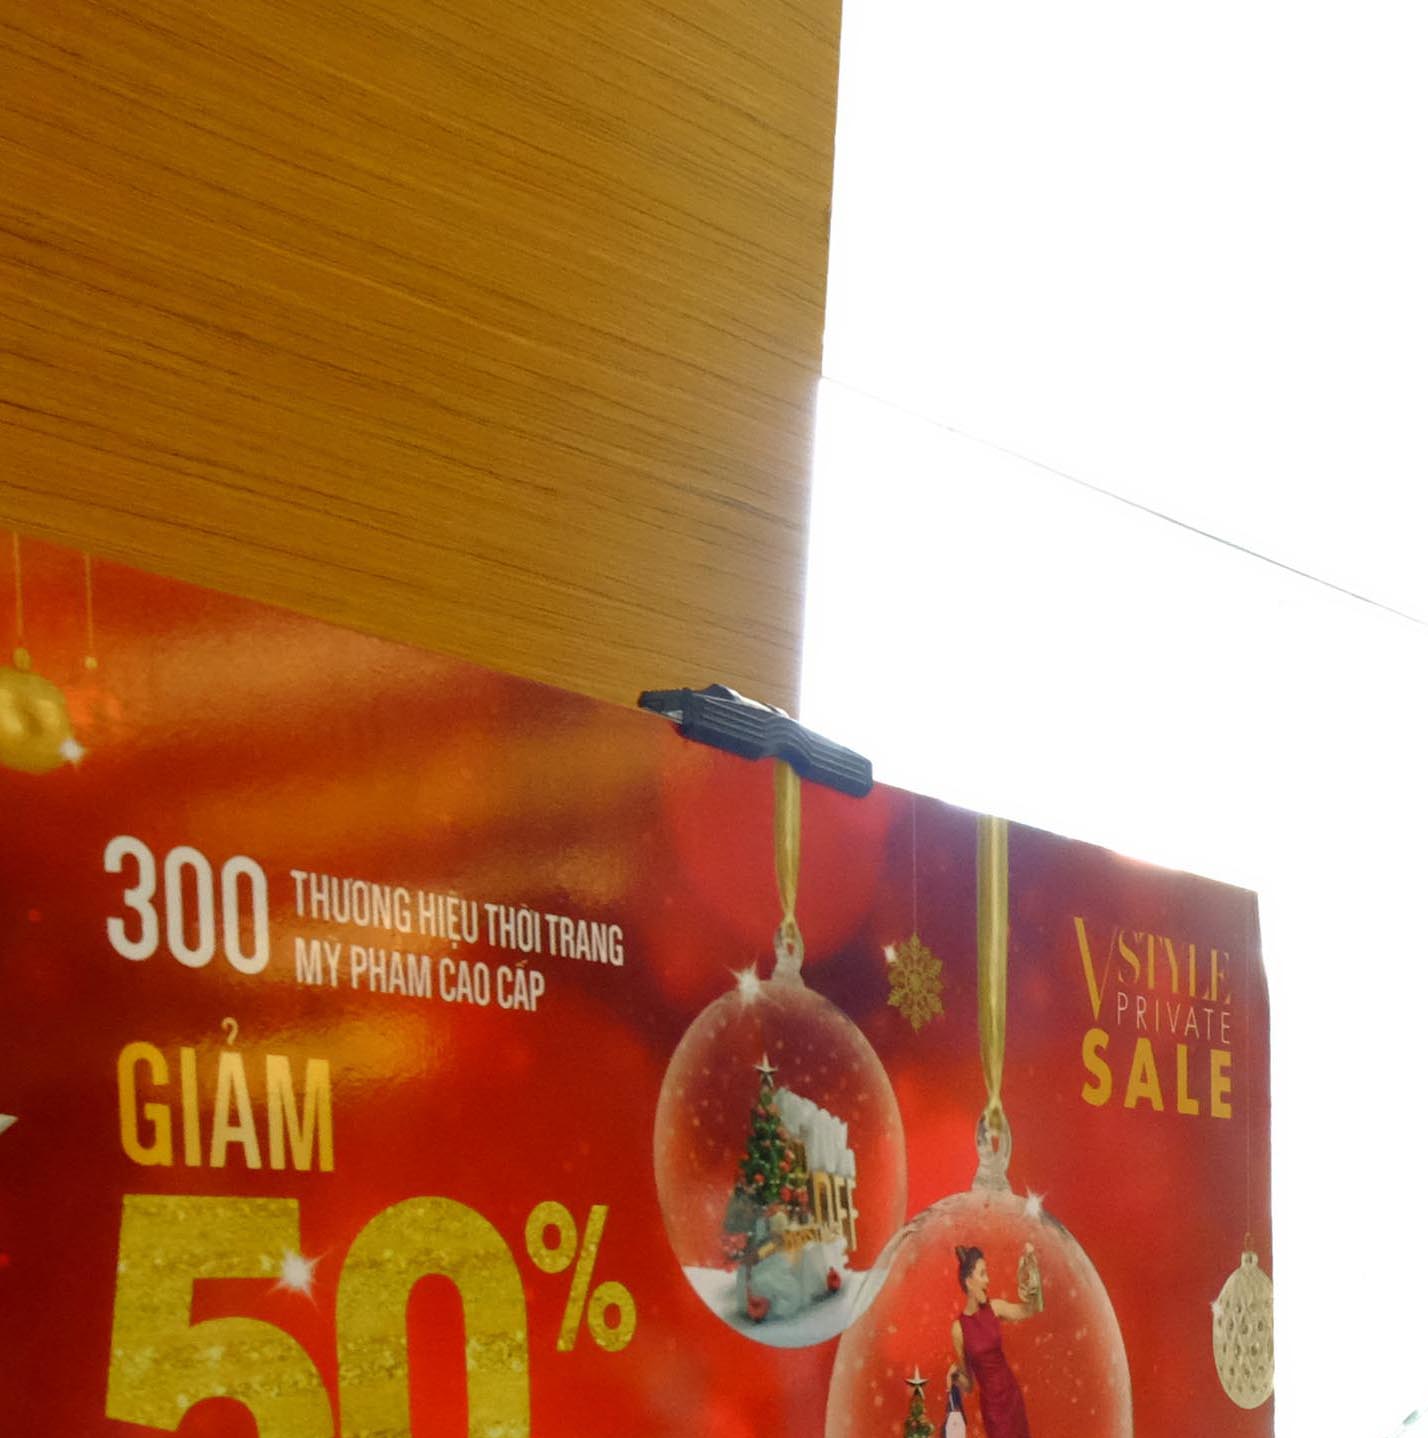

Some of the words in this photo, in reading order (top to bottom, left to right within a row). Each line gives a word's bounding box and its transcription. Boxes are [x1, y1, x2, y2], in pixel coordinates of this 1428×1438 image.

[103, 834, 271, 976] 300
[544, 912, 625, 967] TRANG
[439, 956, 491, 1007] CAO
[1117, 991, 1232, 1045] PRIVATE
[116, 1016, 334, 1173] GIẢM
[1081, 1027, 1233, 1119] SALE
